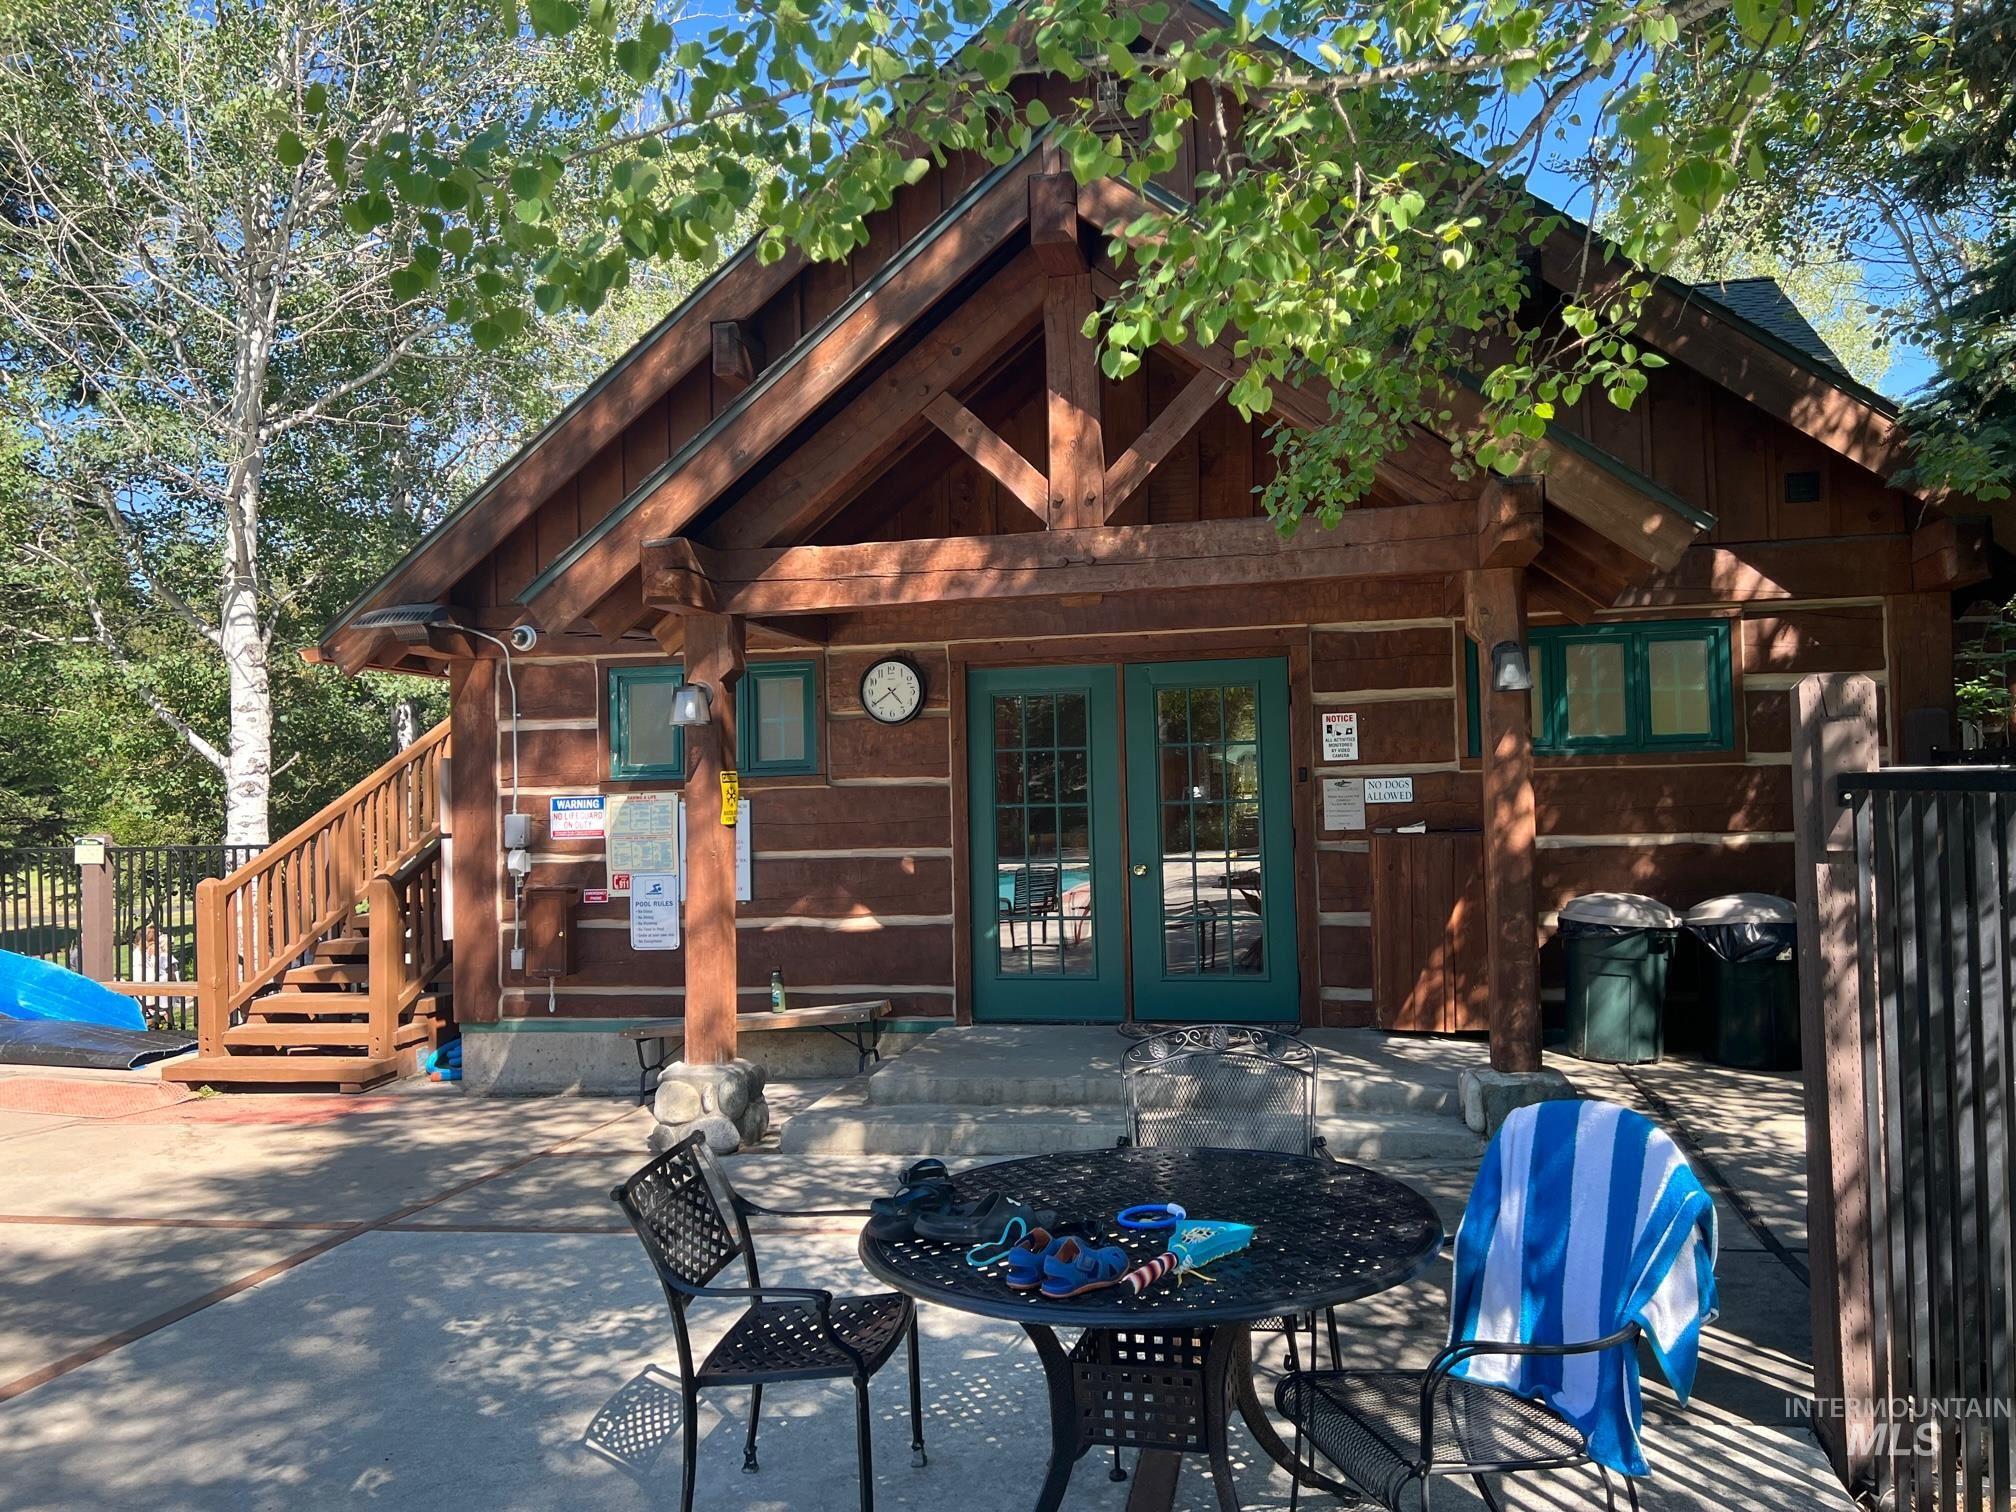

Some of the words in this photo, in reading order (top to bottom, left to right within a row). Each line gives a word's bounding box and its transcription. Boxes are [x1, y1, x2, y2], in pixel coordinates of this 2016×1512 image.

[1368, 780, 1381, 789] NO
[1385, 779, 1410, 789] DOGS
[1367, 791, 1412, 801] ALLOWED
[556, 799, 600, 809] WARNING
[553, 812, 563, 820] NO
[564, 811, 603, 820] LIFEGUARD
[563, 821, 573, 829] ON
[575, 820, 593, 829] DUTY
